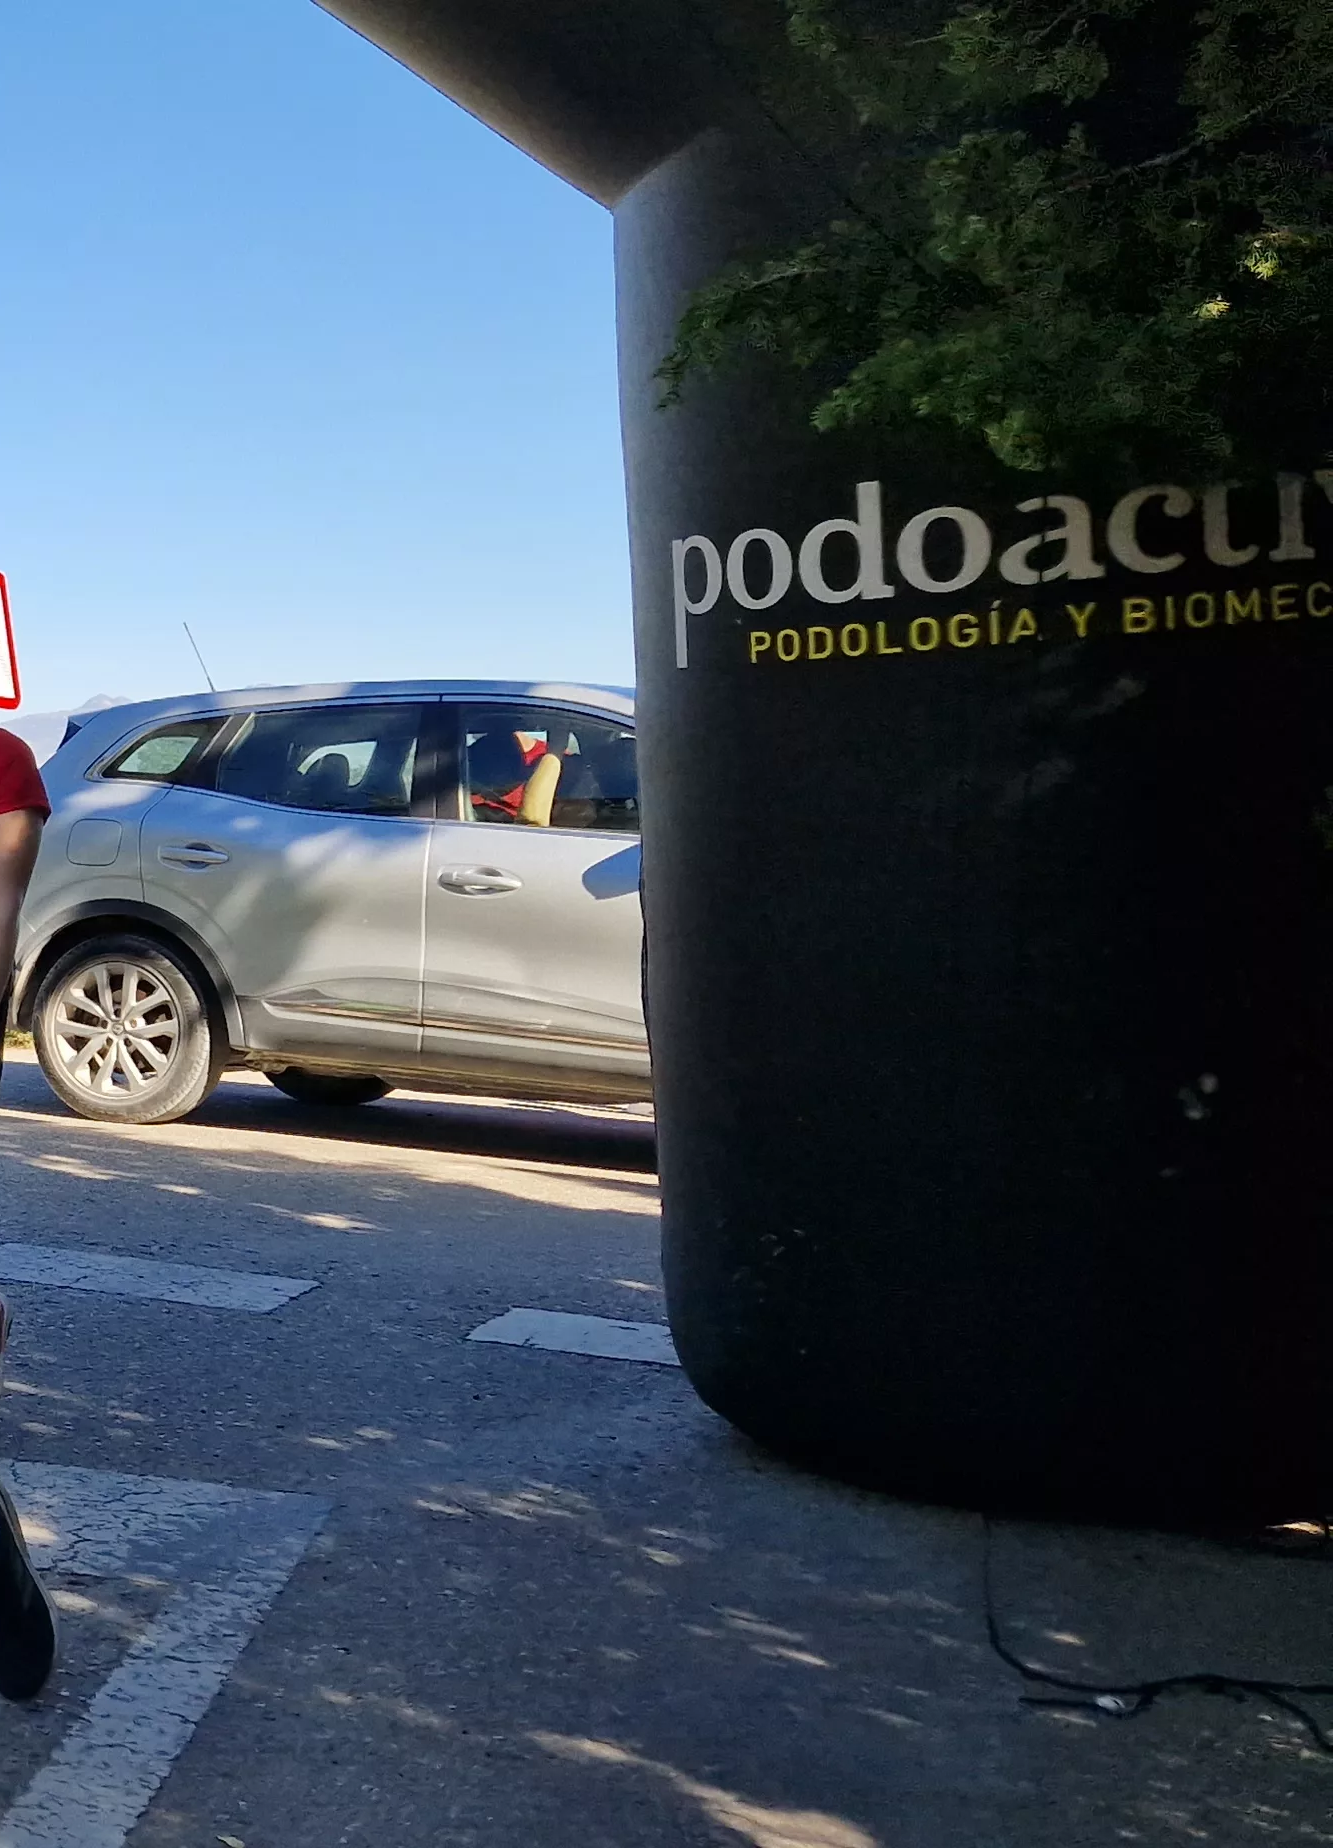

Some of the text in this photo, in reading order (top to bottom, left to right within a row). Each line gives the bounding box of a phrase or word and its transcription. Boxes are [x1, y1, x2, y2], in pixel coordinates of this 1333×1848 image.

[671, 470, 1333, 670] podoacti
[748, 600, 1041, 664] PODOLOGÍA
[1065, 601, 1098, 639] Y
